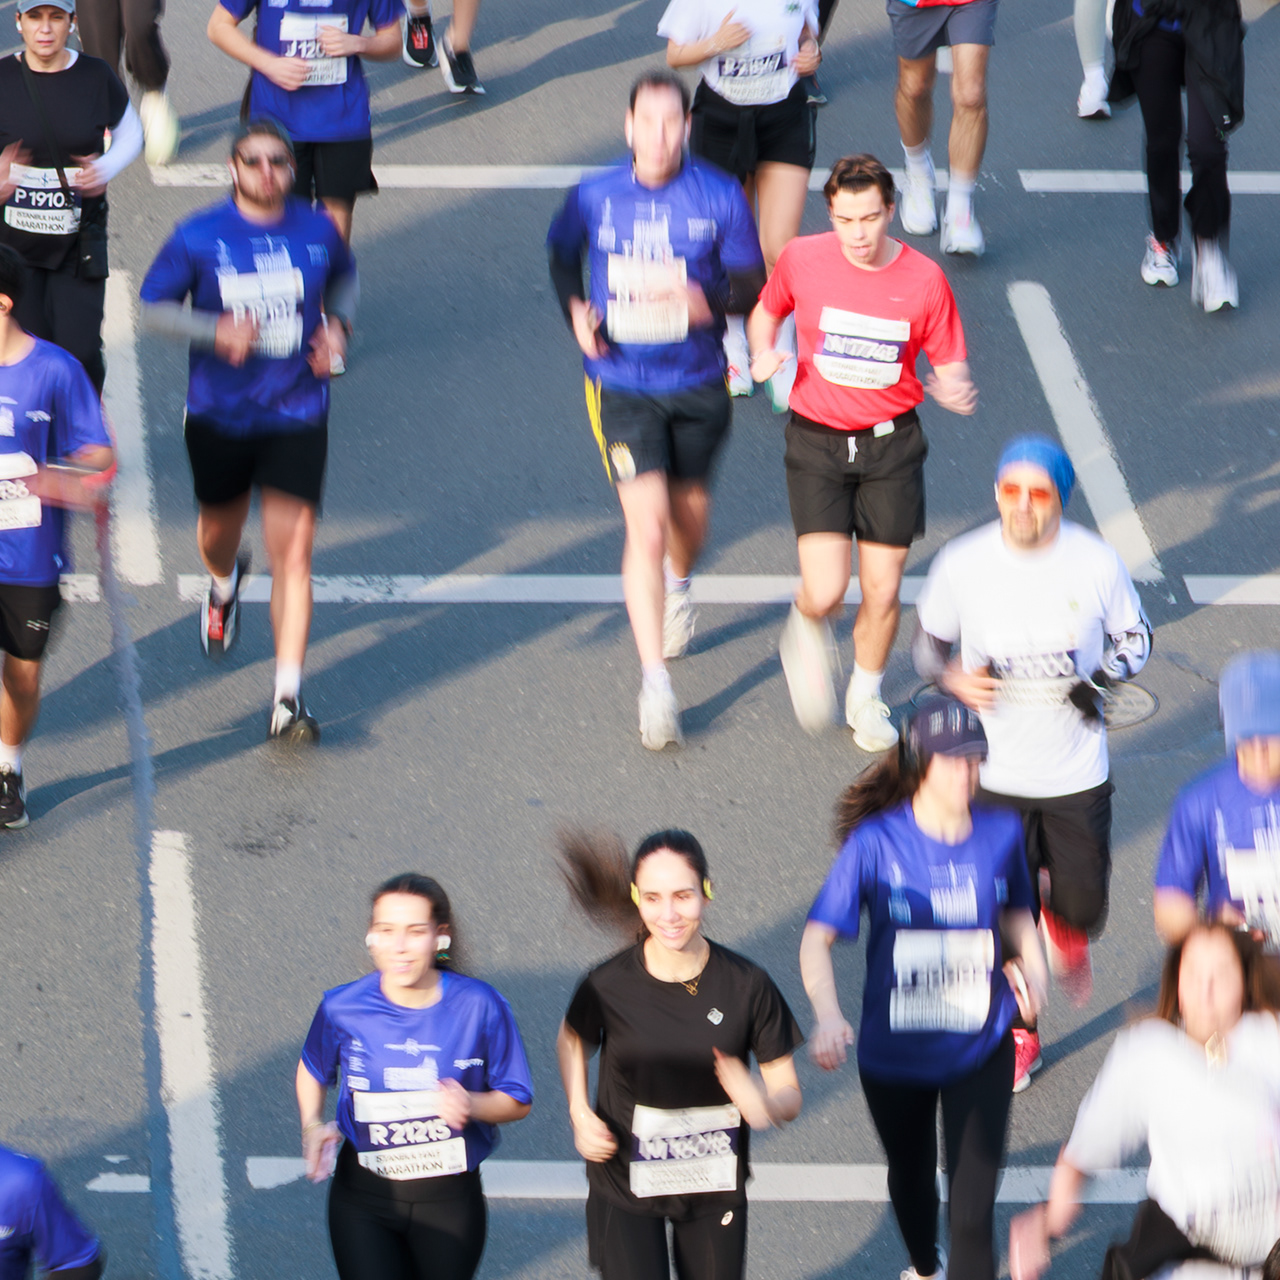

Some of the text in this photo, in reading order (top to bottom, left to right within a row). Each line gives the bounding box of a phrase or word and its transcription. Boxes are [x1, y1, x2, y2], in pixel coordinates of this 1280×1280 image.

[285, 40, 297, 57] J
[15, 187, 75, 208] P 1910
[15, 219, 65, 232] MARATHON
[369, 1118, 452, 1146] R 21215
[375, 1160, 444, 1177] MARATHON
